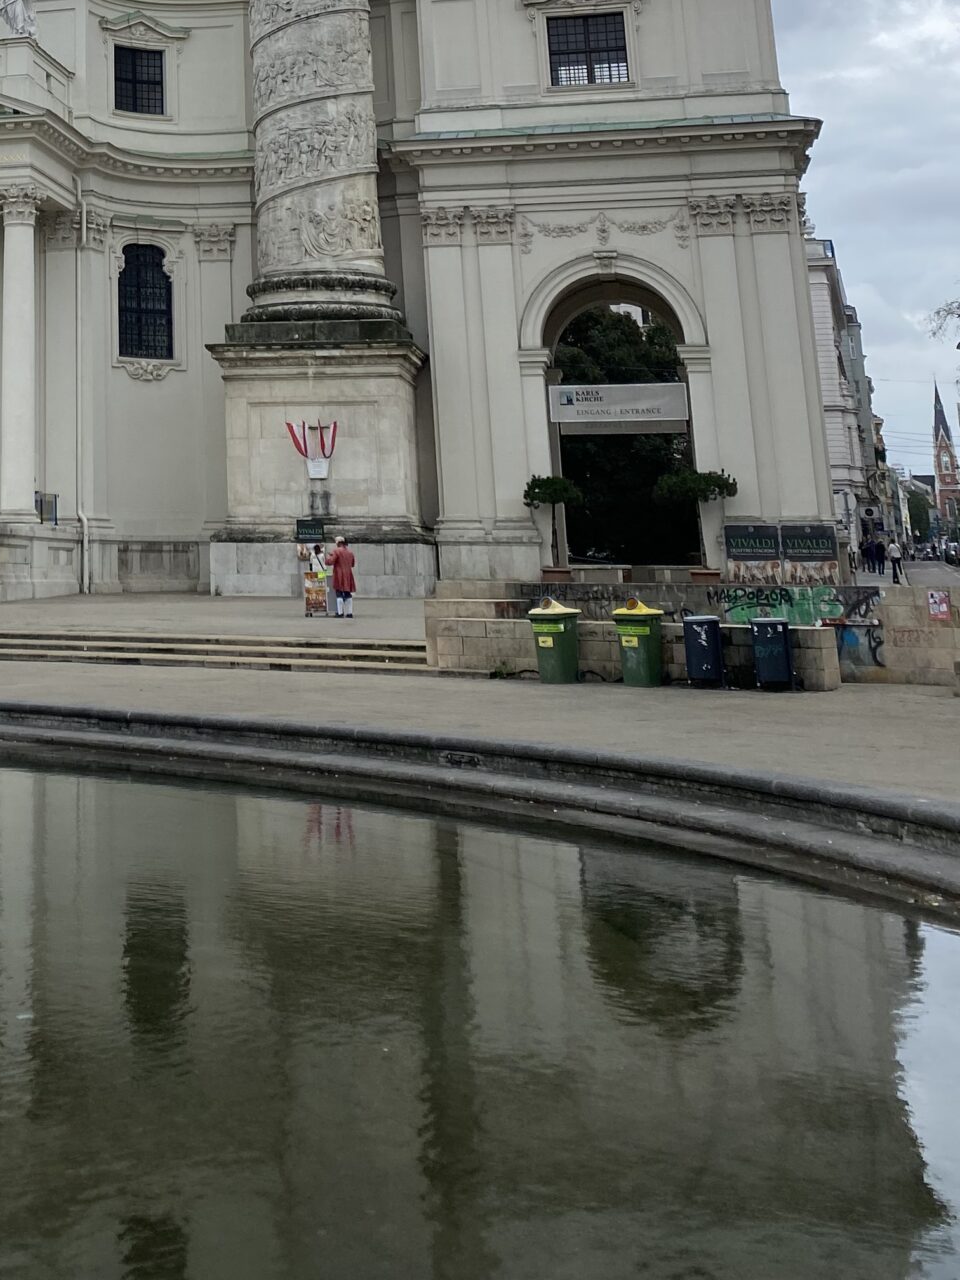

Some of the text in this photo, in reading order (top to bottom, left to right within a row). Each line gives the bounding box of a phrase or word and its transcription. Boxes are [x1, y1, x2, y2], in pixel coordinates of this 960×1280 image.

[576, 407, 662, 416] EINGANG ENTRANCE
[729, 538, 775, 548] VIVALDI
[786, 538, 832, 549] VIVALDI
